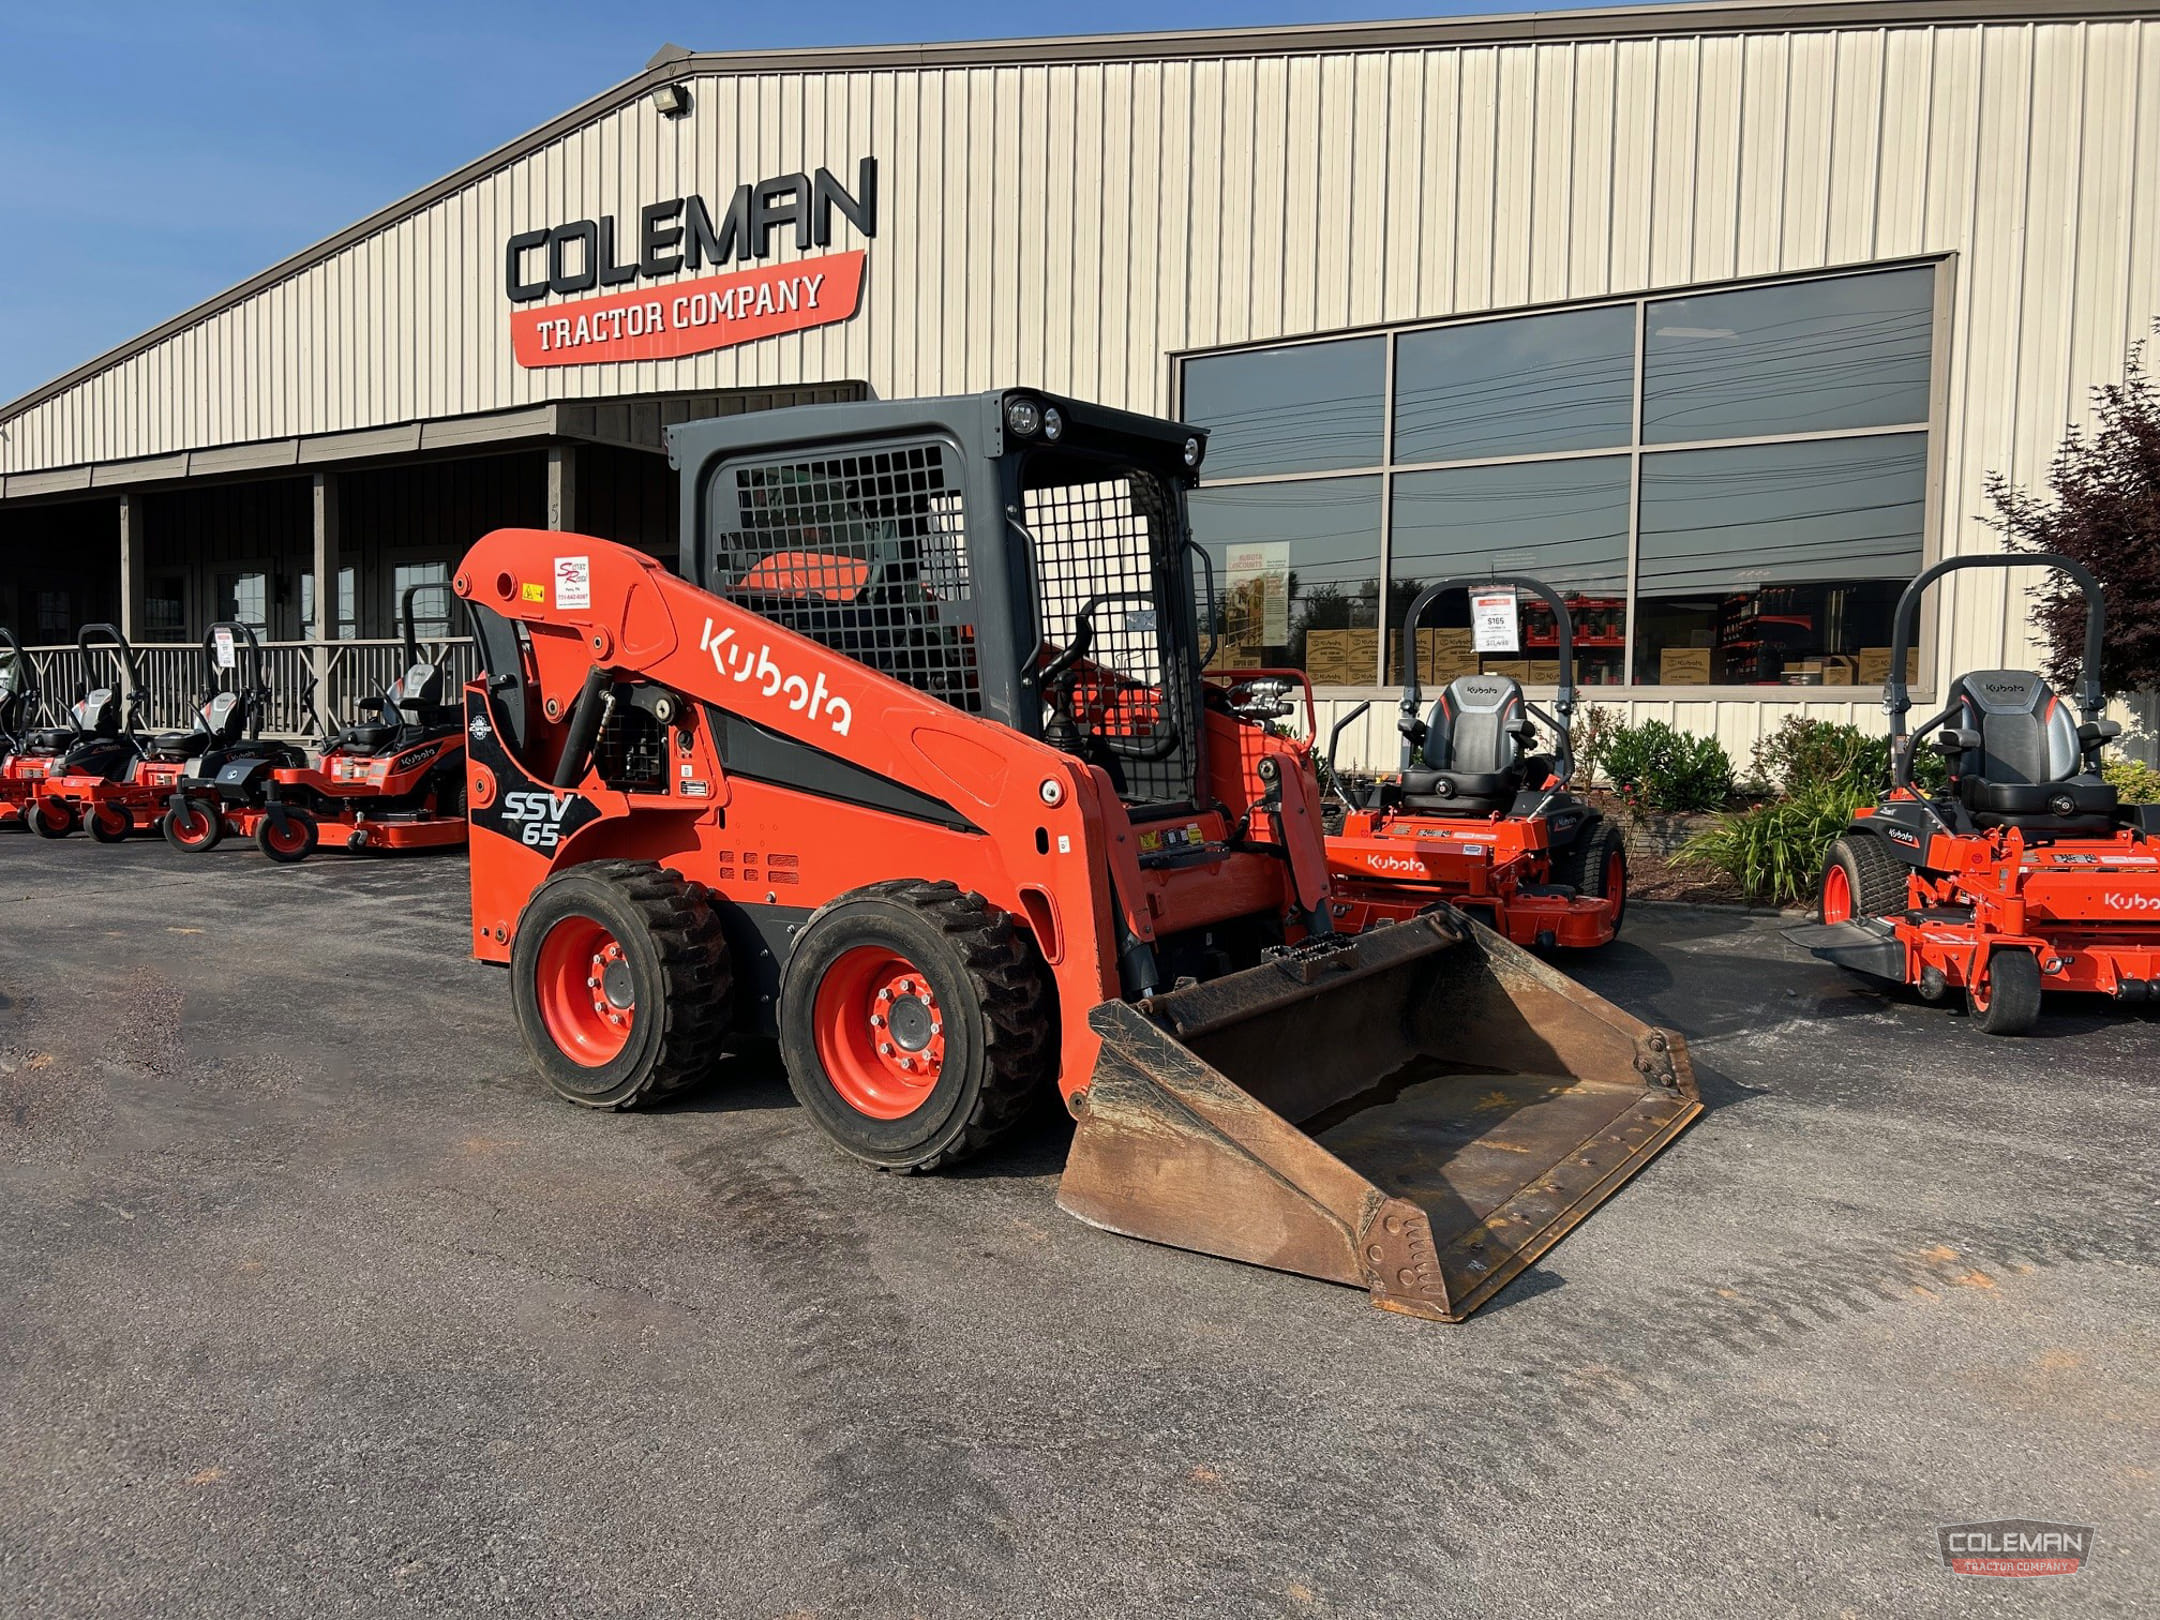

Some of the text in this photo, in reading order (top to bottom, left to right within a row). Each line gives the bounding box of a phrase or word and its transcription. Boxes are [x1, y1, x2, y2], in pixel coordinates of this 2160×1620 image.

[505, 156, 878, 302] COLEMAN
[536, 274, 826, 350] TRACTOR COMPANY
[700, 617, 852, 737] Kubota
[1986, 684, 2025, 692] Kubota
[1467, 686, 1498, 694] Kubota
[401, 748, 435, 766] Kubota
[501, 791, 574, 822] SSV
[522, 822, 560, 847] 65
[1888, 828, 1914, 842] Kubota
[1367, 854, 1426, 873] Kubota
